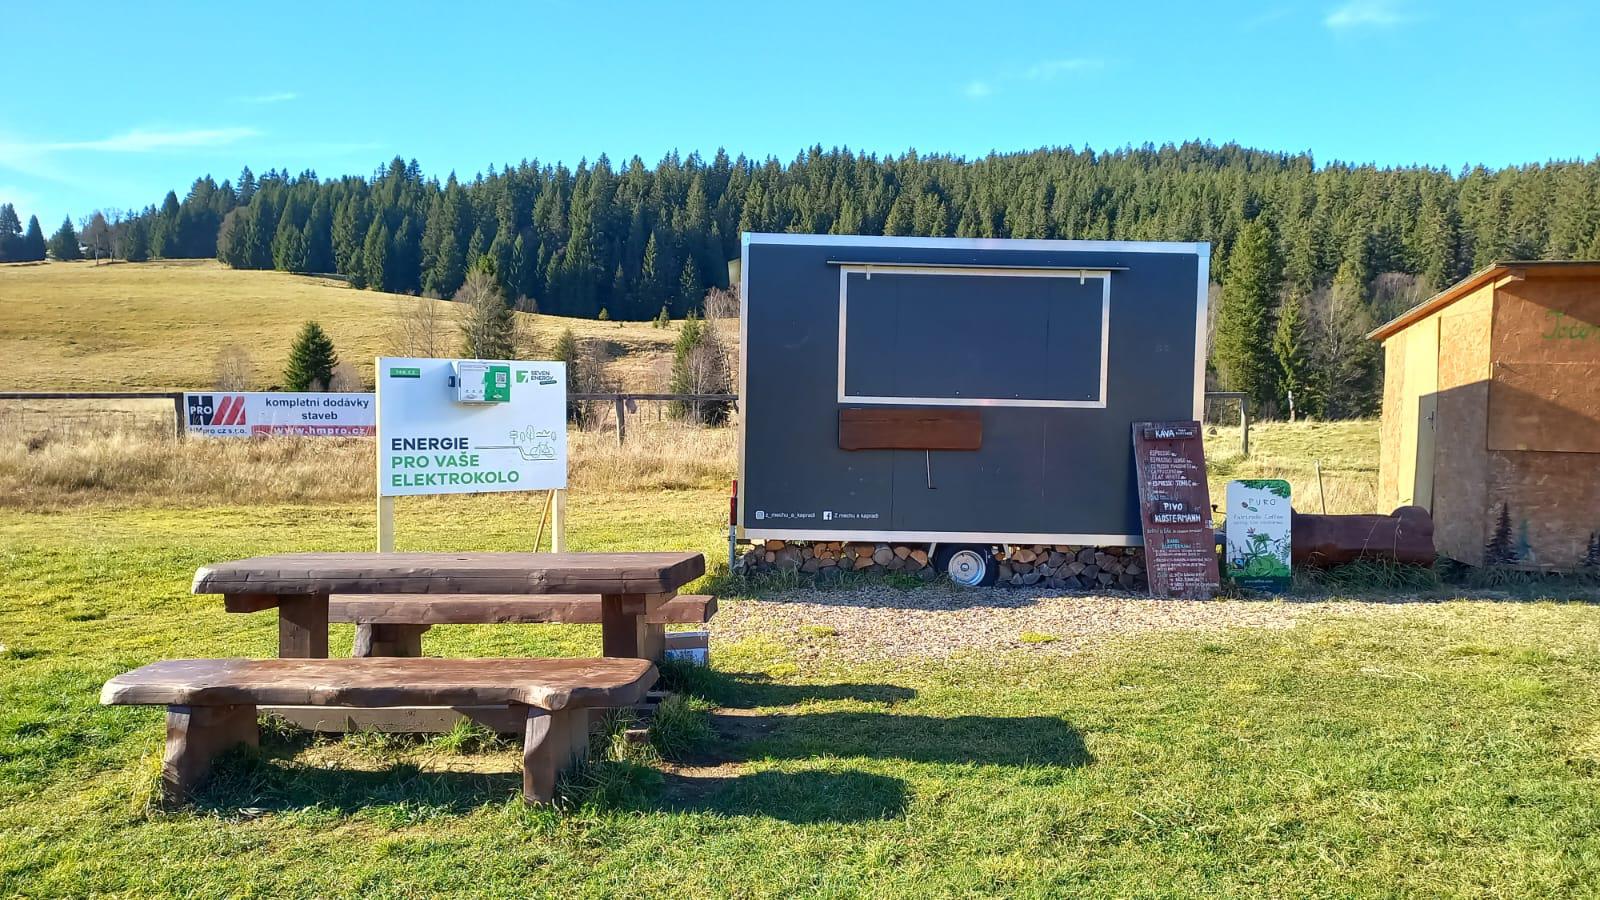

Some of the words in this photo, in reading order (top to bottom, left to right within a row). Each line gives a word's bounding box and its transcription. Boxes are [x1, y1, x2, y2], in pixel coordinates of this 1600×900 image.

[265, 397, 320, 409] kompletní
[323, 397, 369, 409] dodávky
[190, 405, 213, 415] PRO
[301, 411, 338, 420] staveb
[273, 425, 367, 436] www.hmpro.cz
[391, 437, 469, 450] ENERGIE
[391, 455, 429, 469] PRO
[435, 451, 480, 468] VAŠE
[391, 470, 520, 487] ELEKTROKOLO
[1163, 502, 1183, 511] PIVO
[1154, 514, 1201, 522] KLOSTERMANN
